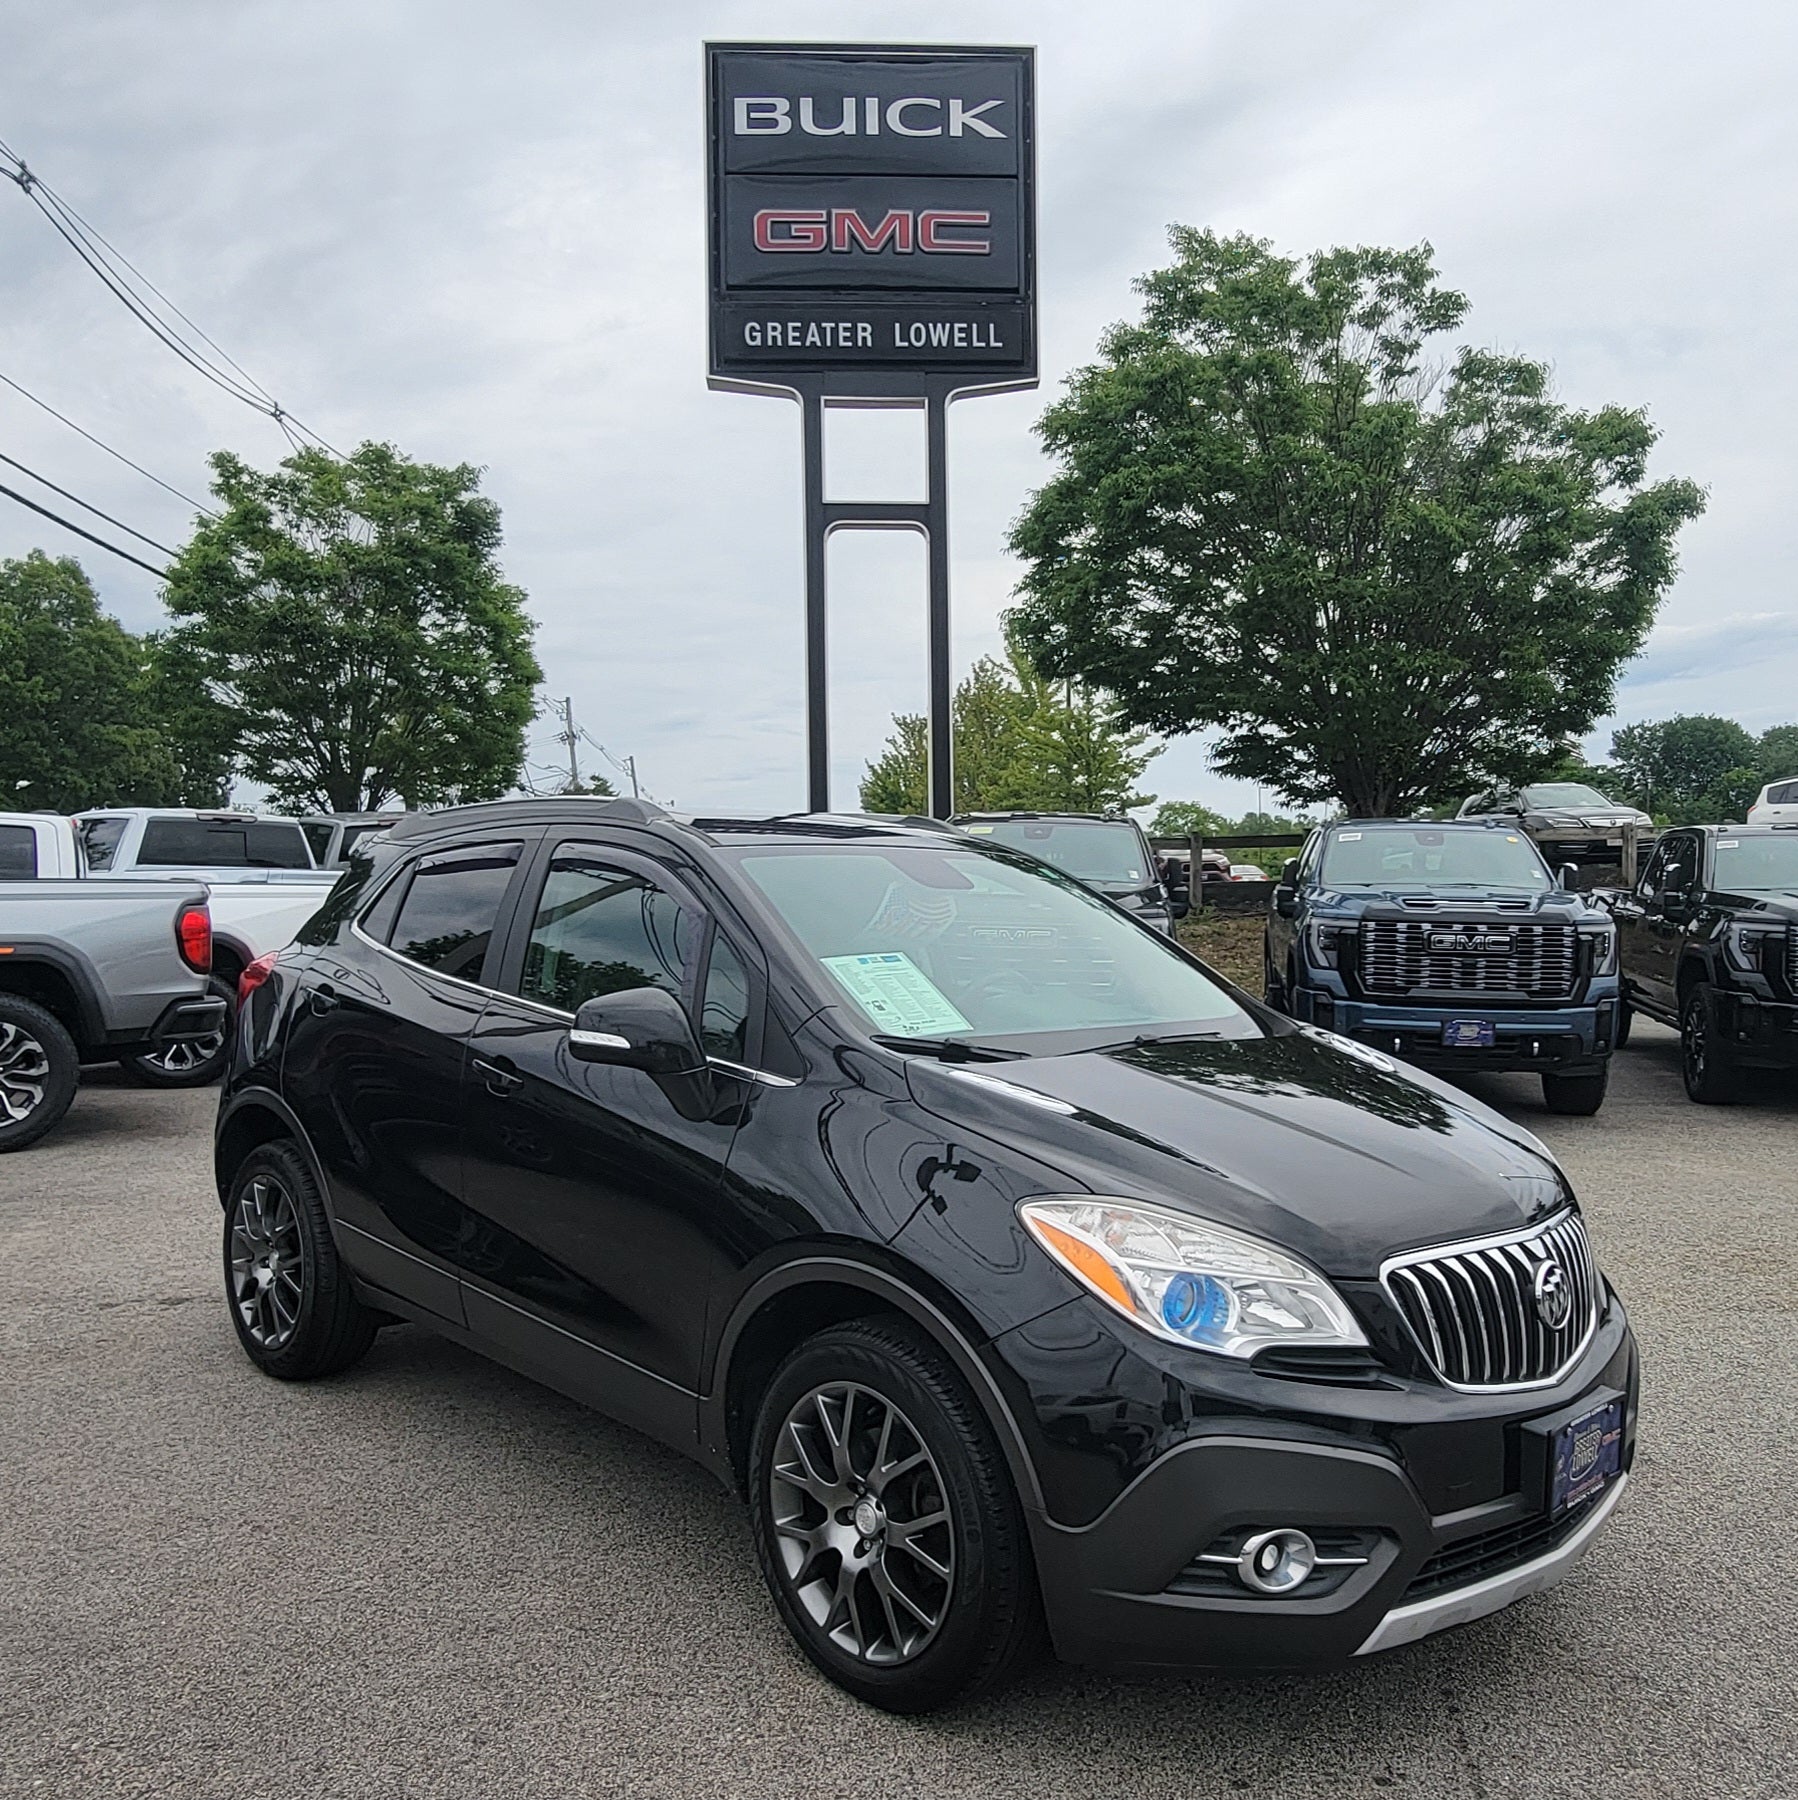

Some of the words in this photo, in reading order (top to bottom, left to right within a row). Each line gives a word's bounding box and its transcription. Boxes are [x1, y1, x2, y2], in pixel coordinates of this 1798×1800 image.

[734, 97, 1007, 138] BUICK
[753, 208, 991, 254] GMC
[744, 322, 873, 347] GREATER
[894, 323, 1003, 348] LOWELL
[1430, 934, 1510, 951] GMC
